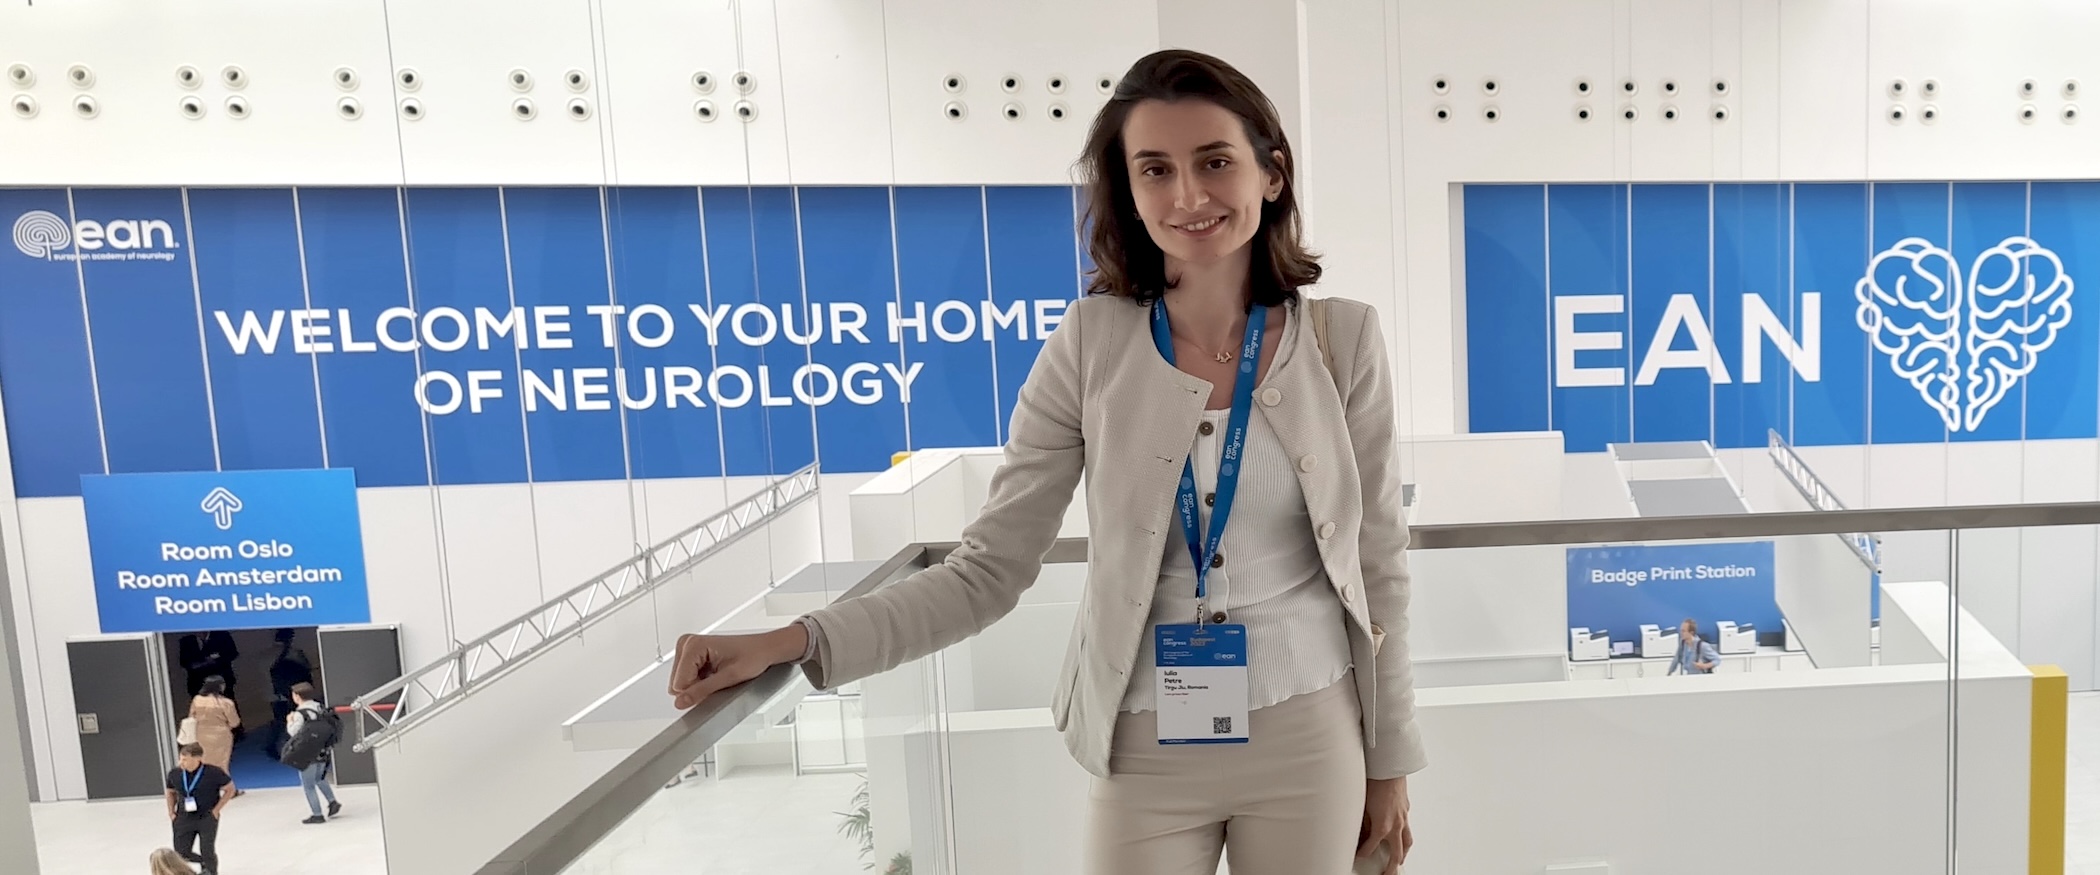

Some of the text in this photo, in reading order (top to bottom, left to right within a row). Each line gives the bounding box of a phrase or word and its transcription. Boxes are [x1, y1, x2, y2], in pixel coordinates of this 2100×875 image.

[53, 252, 90, 261] europan
[127, 252, 135, 260] of
[136, 251, 175, 262] neurology
[213, 299, 1067, 355] WELCOME TO YOUR HOME
[1554, 292, 1821, 388] EAN
[1249, 329, 1259, 359] congress
[413, 361, 924, 416] OF NEUROLOGY
[1230, 428, 1241, 460] congress
[1182, 493, 1193, 529] congress
[160, 539, 293, 562] Room Oslo
[117, 564, 342, 590] Room Amsterdam
[1591, 563, 1756, 587] Badge Print Station
[155, 592, 312, 615] Room Lisbon
